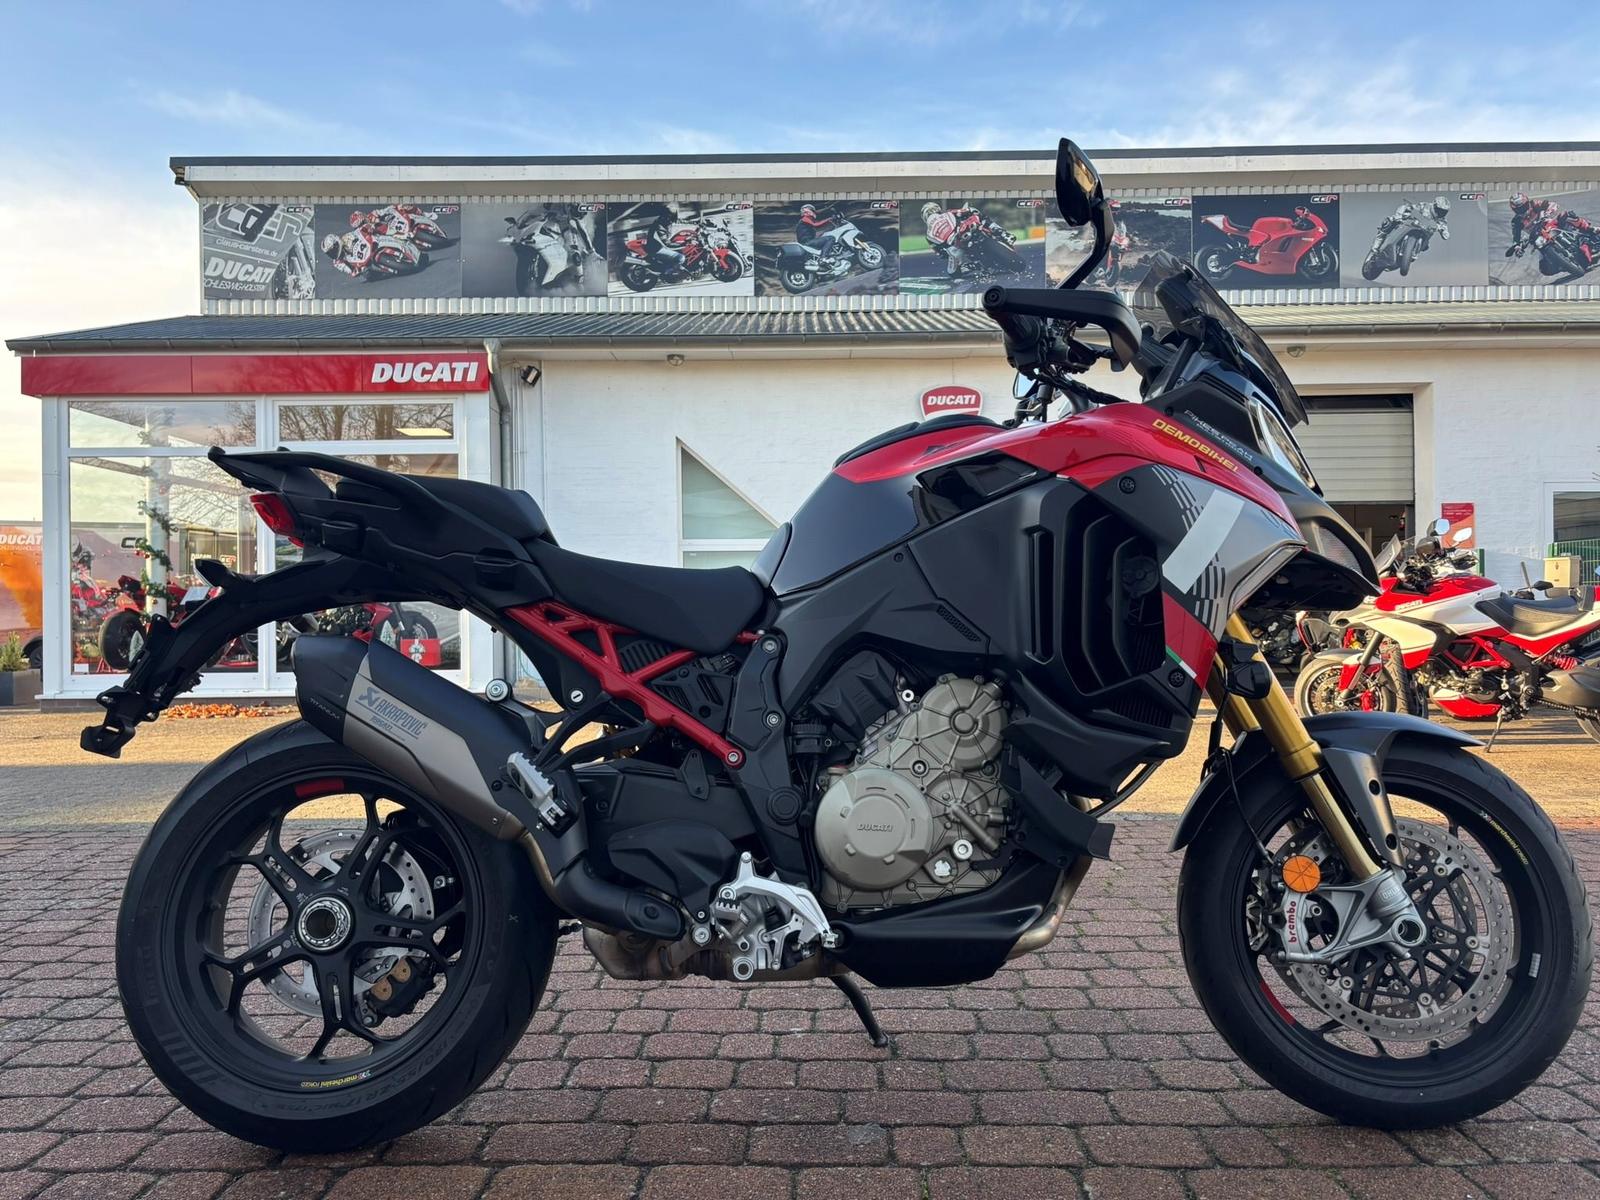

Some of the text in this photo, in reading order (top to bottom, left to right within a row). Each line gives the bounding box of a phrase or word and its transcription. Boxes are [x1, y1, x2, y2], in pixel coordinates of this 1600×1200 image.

[205, 256, 276, 283] DUCATI
[371, 362, 479, 383] DUCATI
[926, 394, 977, 405] DUCATI
[856, 823, 894, 832] DUCATI
